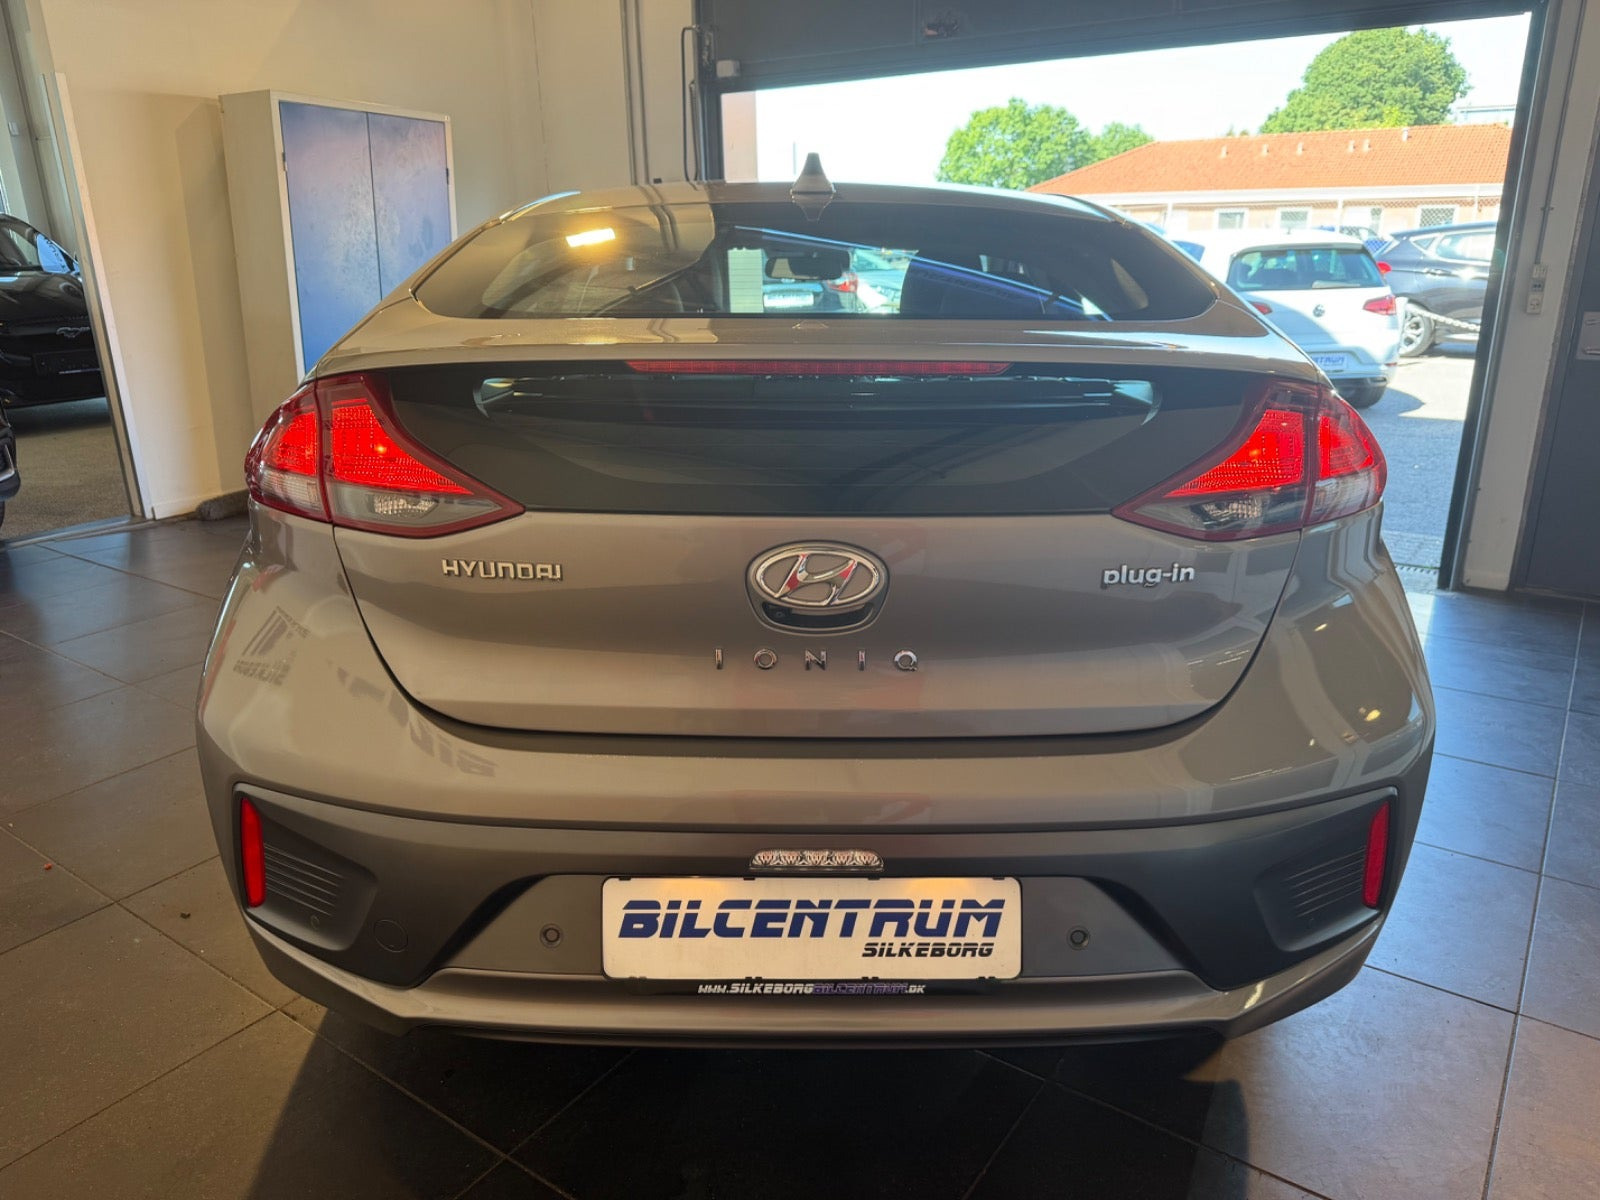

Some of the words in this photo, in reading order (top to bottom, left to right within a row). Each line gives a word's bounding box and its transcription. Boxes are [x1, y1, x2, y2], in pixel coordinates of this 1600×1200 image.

[441, 559, 563, 581] HYUNDAI
[1102, 563, 1196, 588] plug-in
[714, 649, 918, 672] IONIQ
[618, 899, 1006, 939] BILCENTRUM
[862, 942, 995, 958] SILKEBORG
